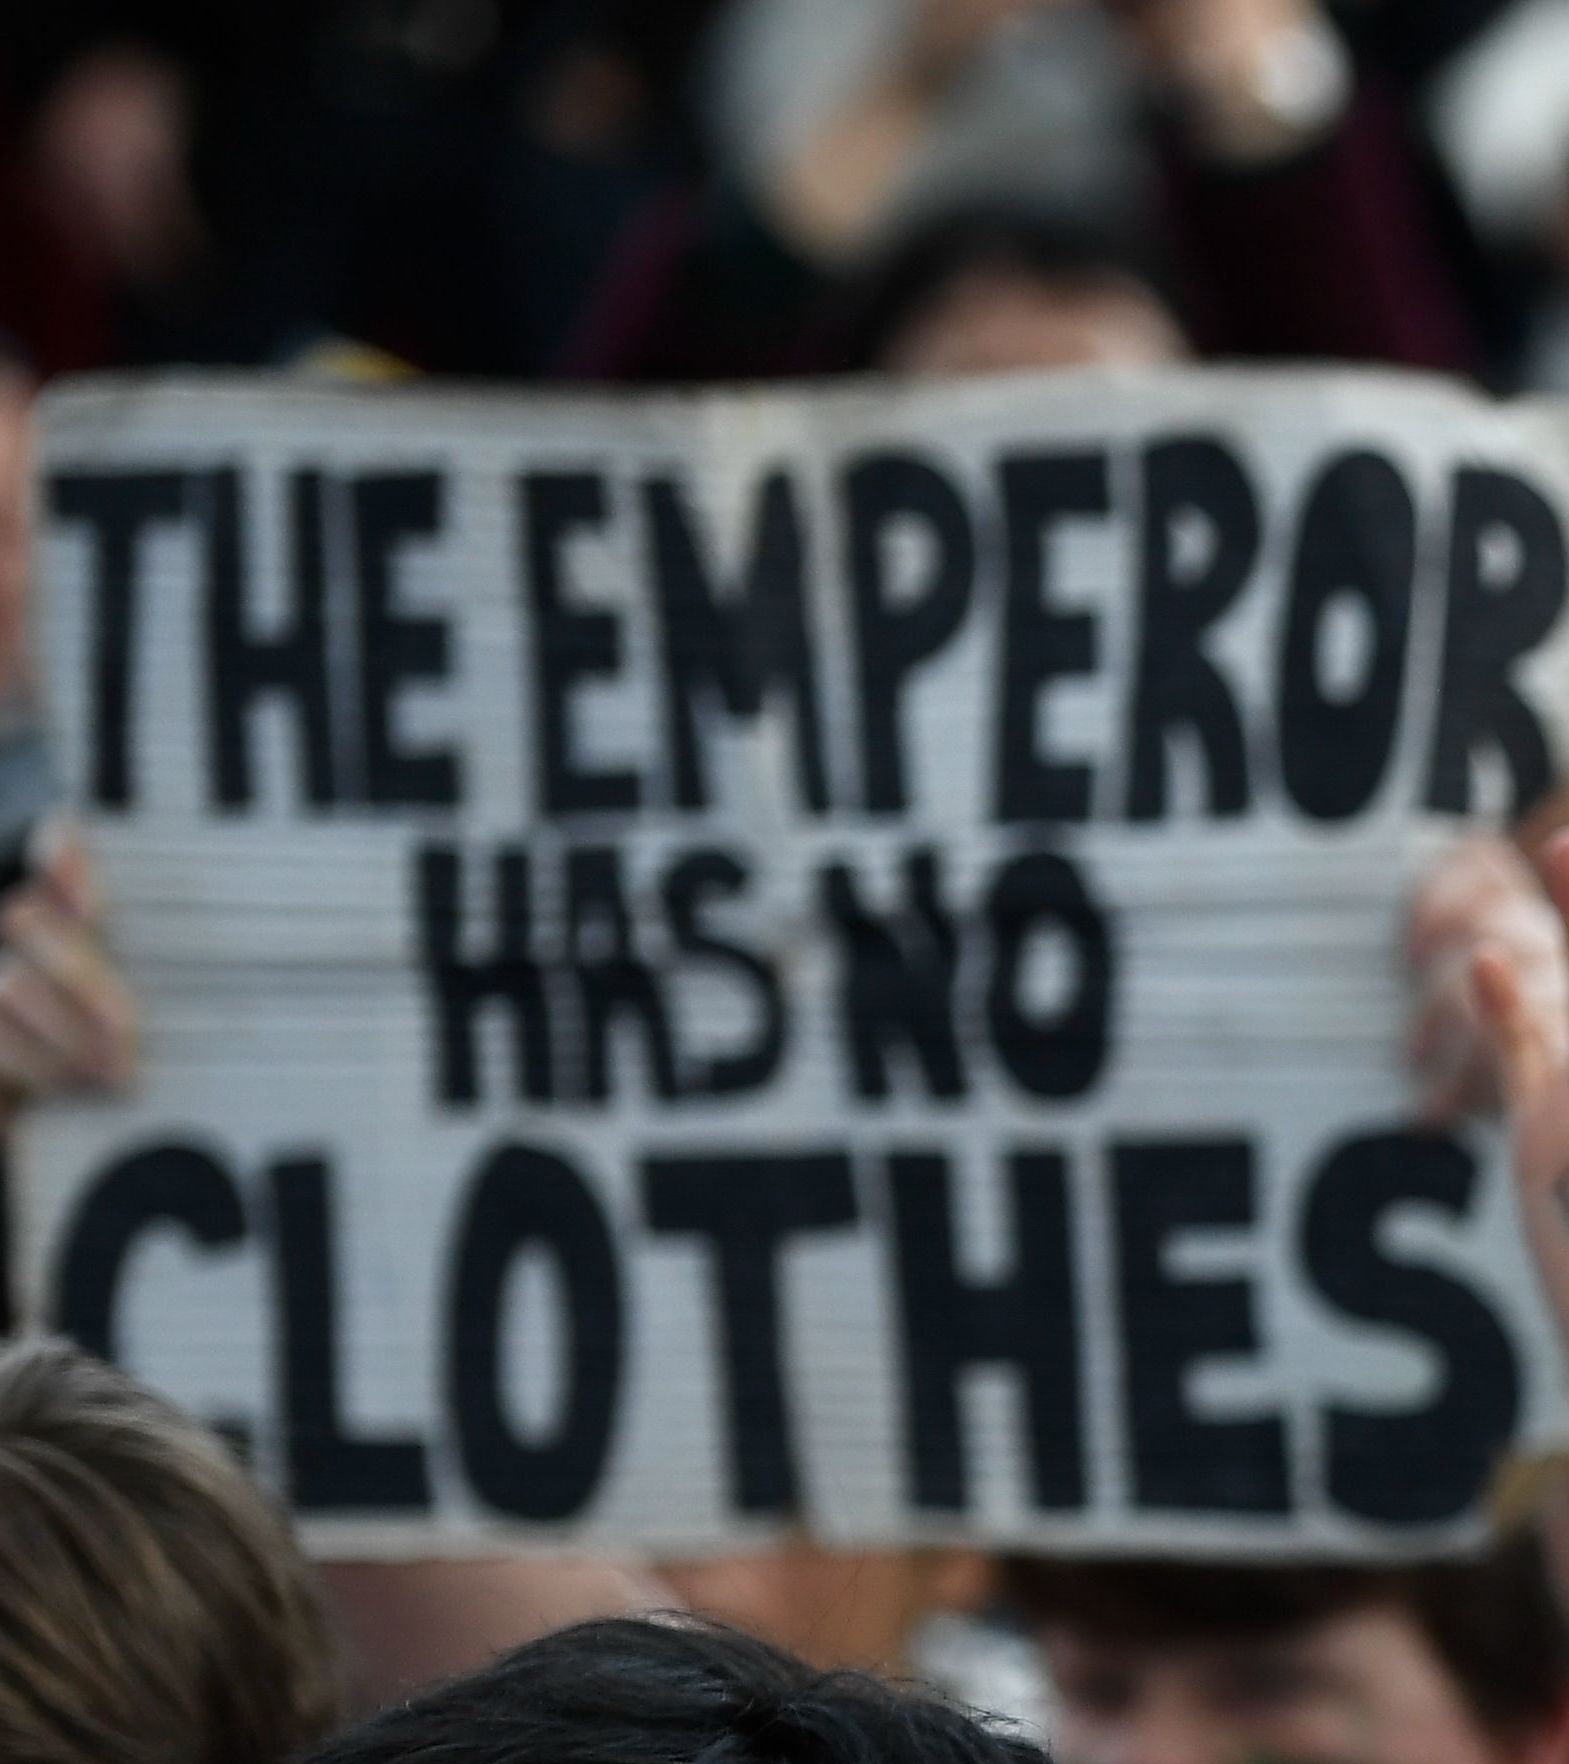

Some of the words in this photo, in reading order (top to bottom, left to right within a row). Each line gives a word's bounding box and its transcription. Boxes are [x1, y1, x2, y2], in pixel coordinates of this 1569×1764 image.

[48, 462, 462, 812] THE
[414, 844, 792, 1109] HAS
[812, 846, 1117, 1109] NO
[56, 1126, 1524, 1526] CLOTHES
